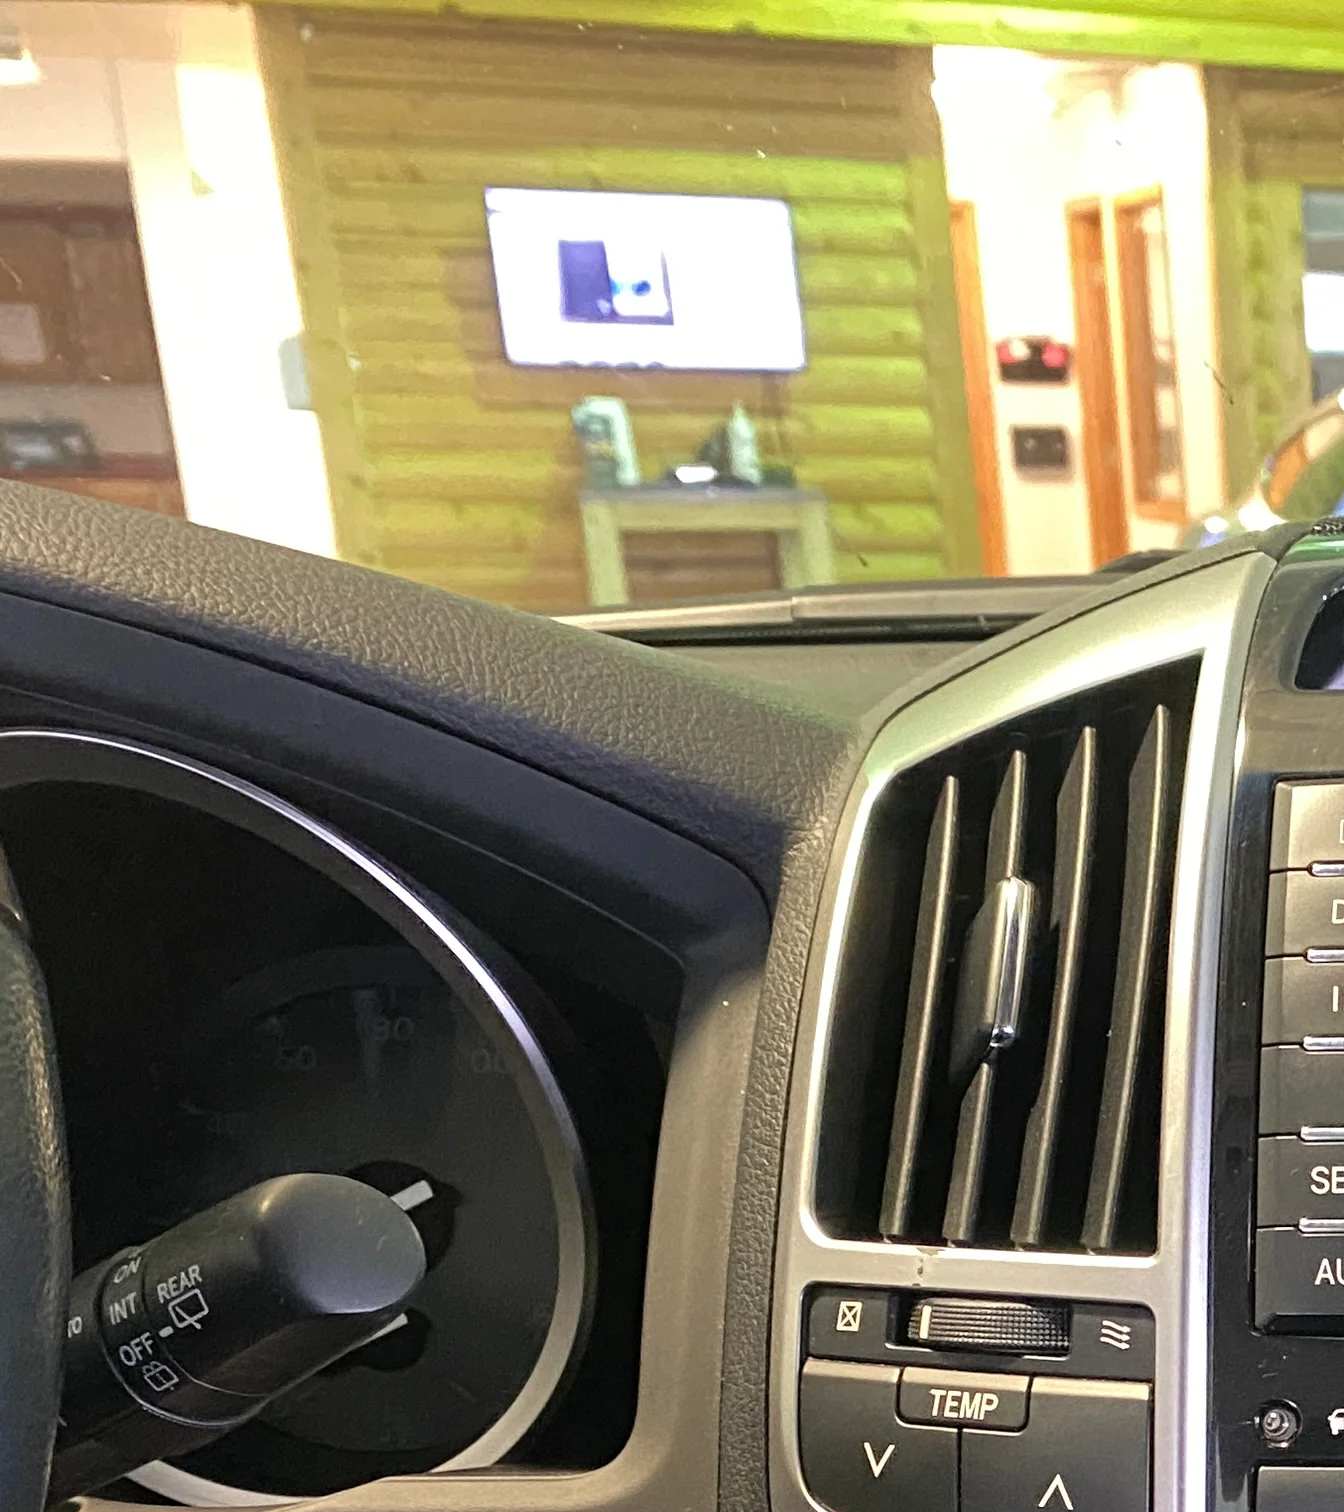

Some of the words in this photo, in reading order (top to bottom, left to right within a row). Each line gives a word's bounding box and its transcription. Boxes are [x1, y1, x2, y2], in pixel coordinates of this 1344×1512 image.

[113, 1256, 142, 1284] ON
[156, 1264, 203, 1304] REAR
[109, 1292, 137, 1326] INT
[119, 1332, 154, 1367] OFF
[930, 1388, 999, 1420] TEMP
